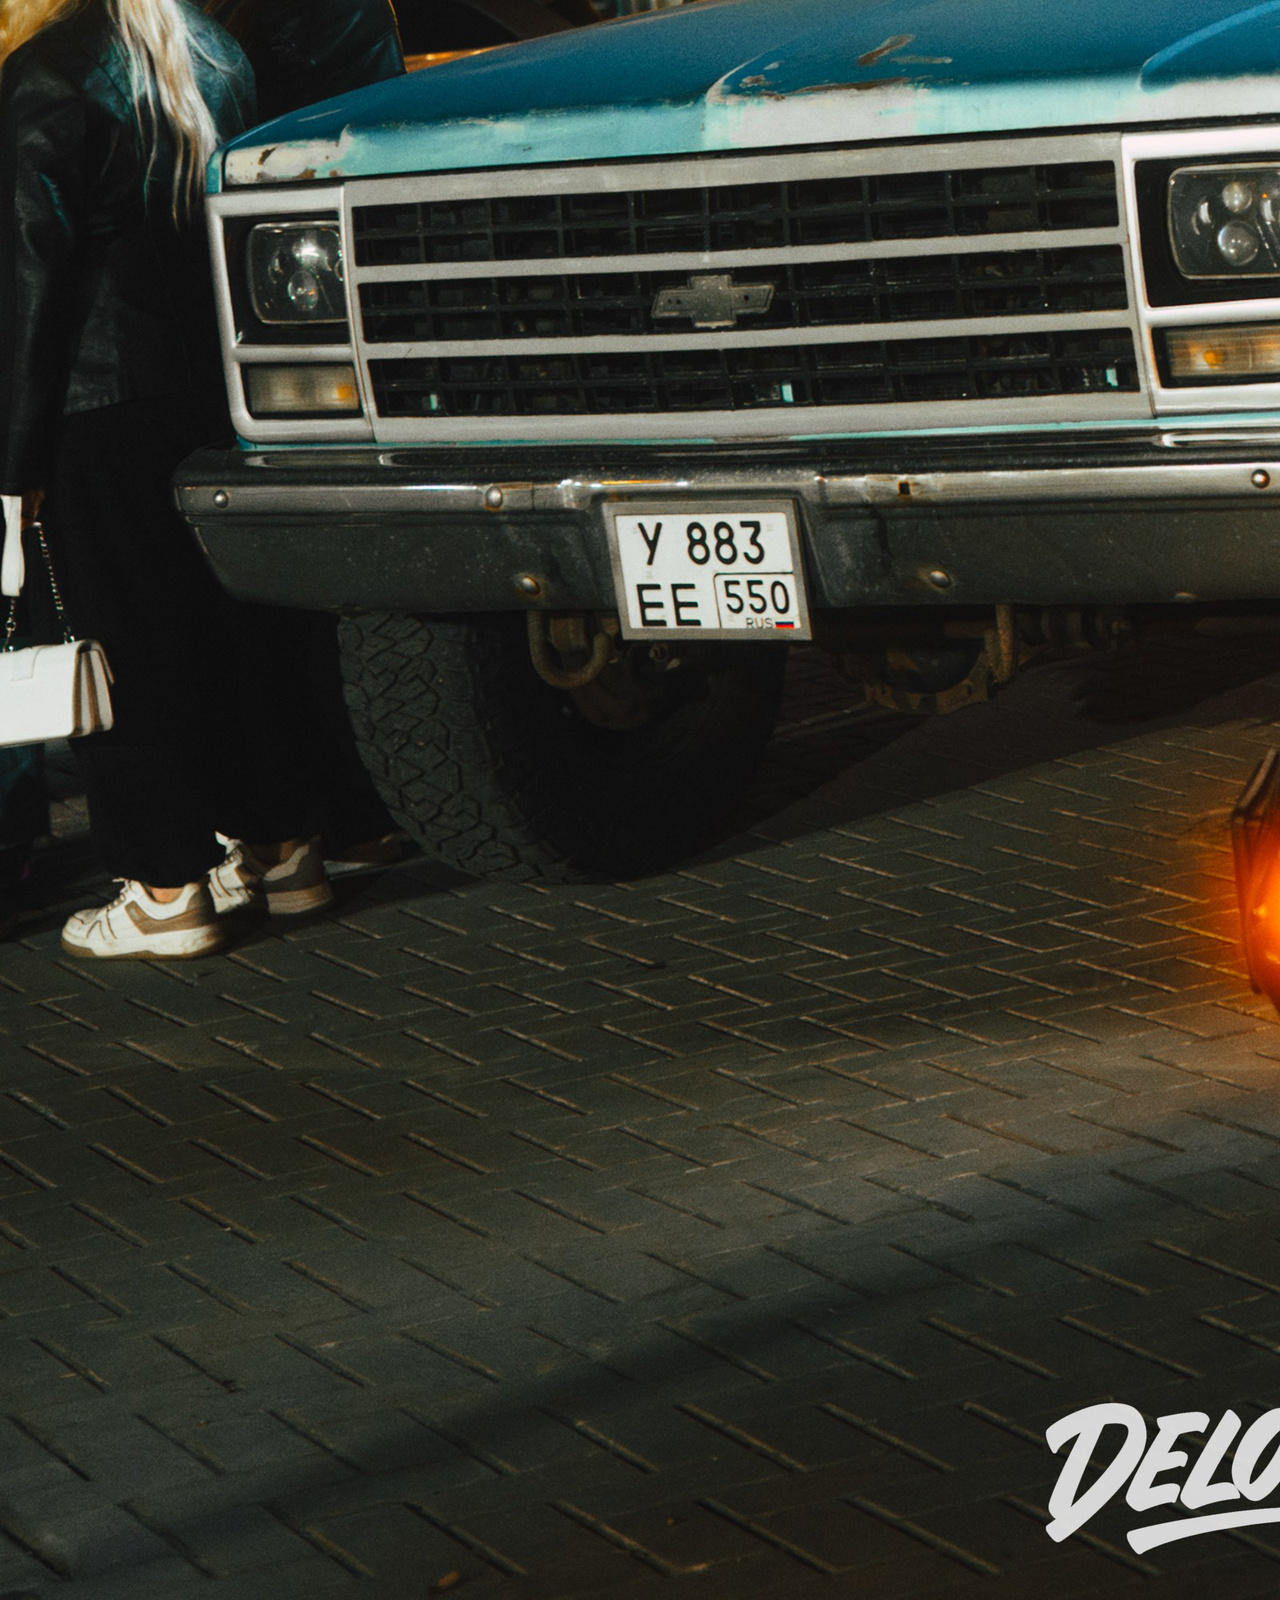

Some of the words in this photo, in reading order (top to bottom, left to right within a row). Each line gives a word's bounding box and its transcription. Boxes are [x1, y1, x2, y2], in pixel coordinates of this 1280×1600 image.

[686, 520, 765, 566] 883
[636, 582, 702, 627] ЕЕ
[724, 579, 790, 615] 550
[746, 617, 774, 630] RUS
